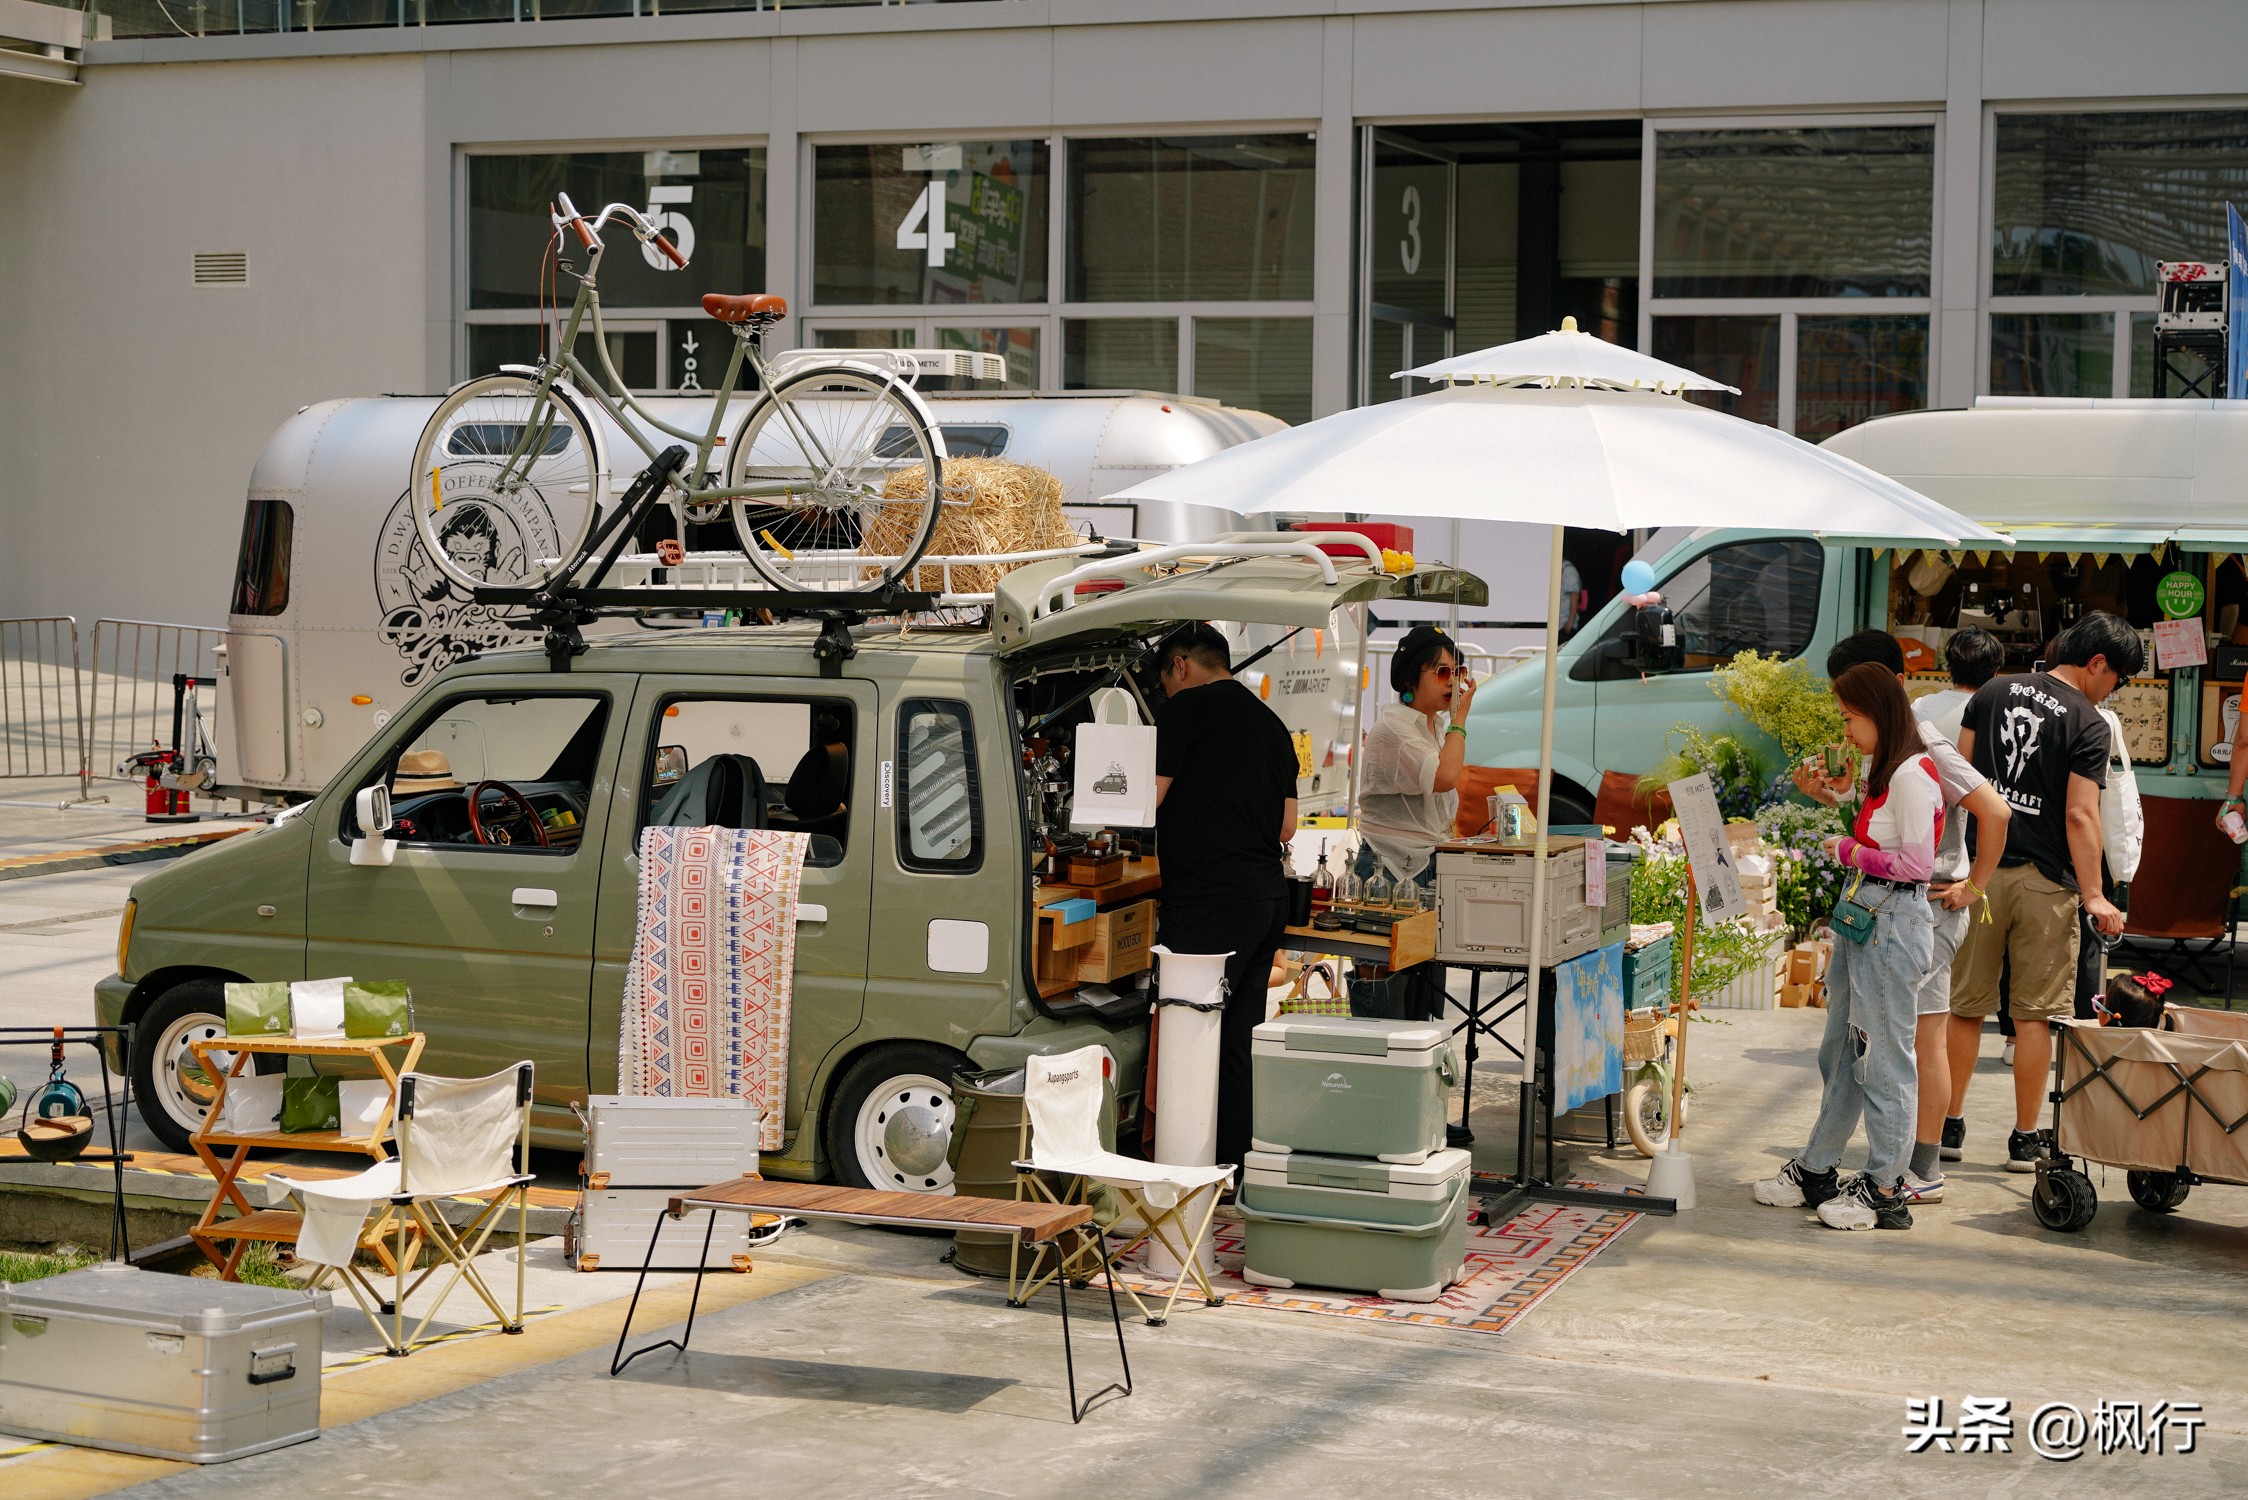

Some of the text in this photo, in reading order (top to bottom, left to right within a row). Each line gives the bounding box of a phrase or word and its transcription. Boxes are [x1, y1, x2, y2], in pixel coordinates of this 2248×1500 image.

[641, 185, 696, 272] 5
[897, 181, 956, 268] 4
[1400, 185, 1421, 275] 3
[440, 474, 497, 494] OFFEE
[508, 491, 550, 558] OMPAN
[567, 550, 589, 574] Atorack
[2166, 581, 2196, 590] HAPPY
[2168, 589, 2193, 598] HOUR
[2142, 638, 2151, 672] OATSIDE
[1277, 680, 1292, 696] THE
[2009, 682, 2068, 718] HORDE
[882, 765, 892, 806] Discovery
[1116, 932, 1142, 950] WOOD BOX
[1320, 1080, 1353, 1090] Naturehike
